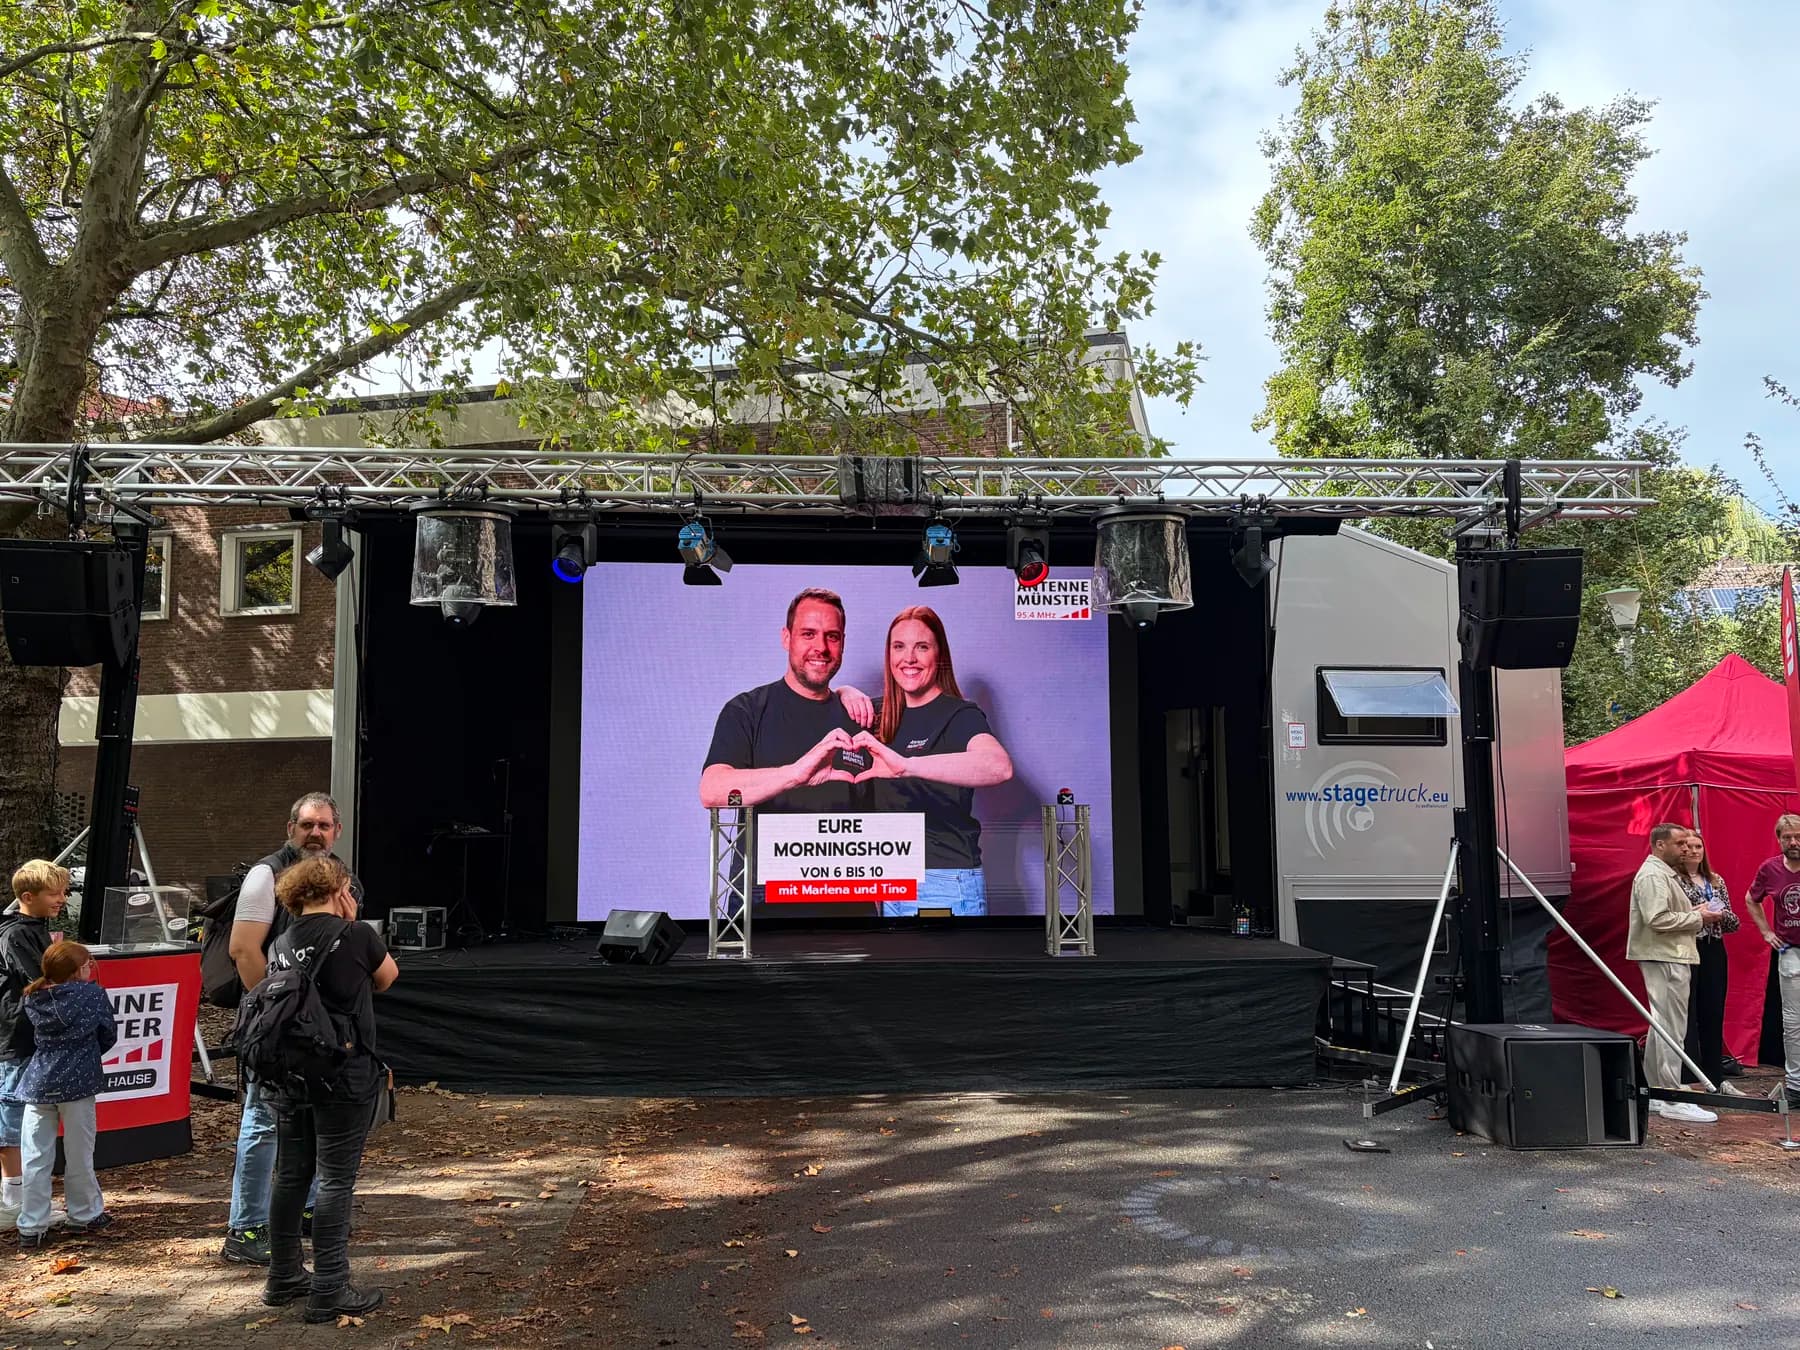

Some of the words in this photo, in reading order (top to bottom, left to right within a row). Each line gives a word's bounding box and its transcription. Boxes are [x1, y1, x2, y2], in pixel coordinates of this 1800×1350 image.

[1017, 592, 1089, 606] MÜNSTER
[1037, 611, 1057, 619] MHz
[1286, 783, 1449, 806] www.stagetruck.eu
[818, 819, 863, 834] EURE
[774, 841, 912, 857] MORNINGSHOW
[800, 867, 830, 878] VON
[833, 866, 842, 878] 6
[846, 866, 865, 877] BIS
[870, 866, 884, 877] 10
[778, 884, 798, 895] mit
[802, 884, 850, 895] Marlena
[854, 883, 878, 894] und
[881, 883, 907, 894] Tino
[108, 1073, 152, 1087] HAUSE
